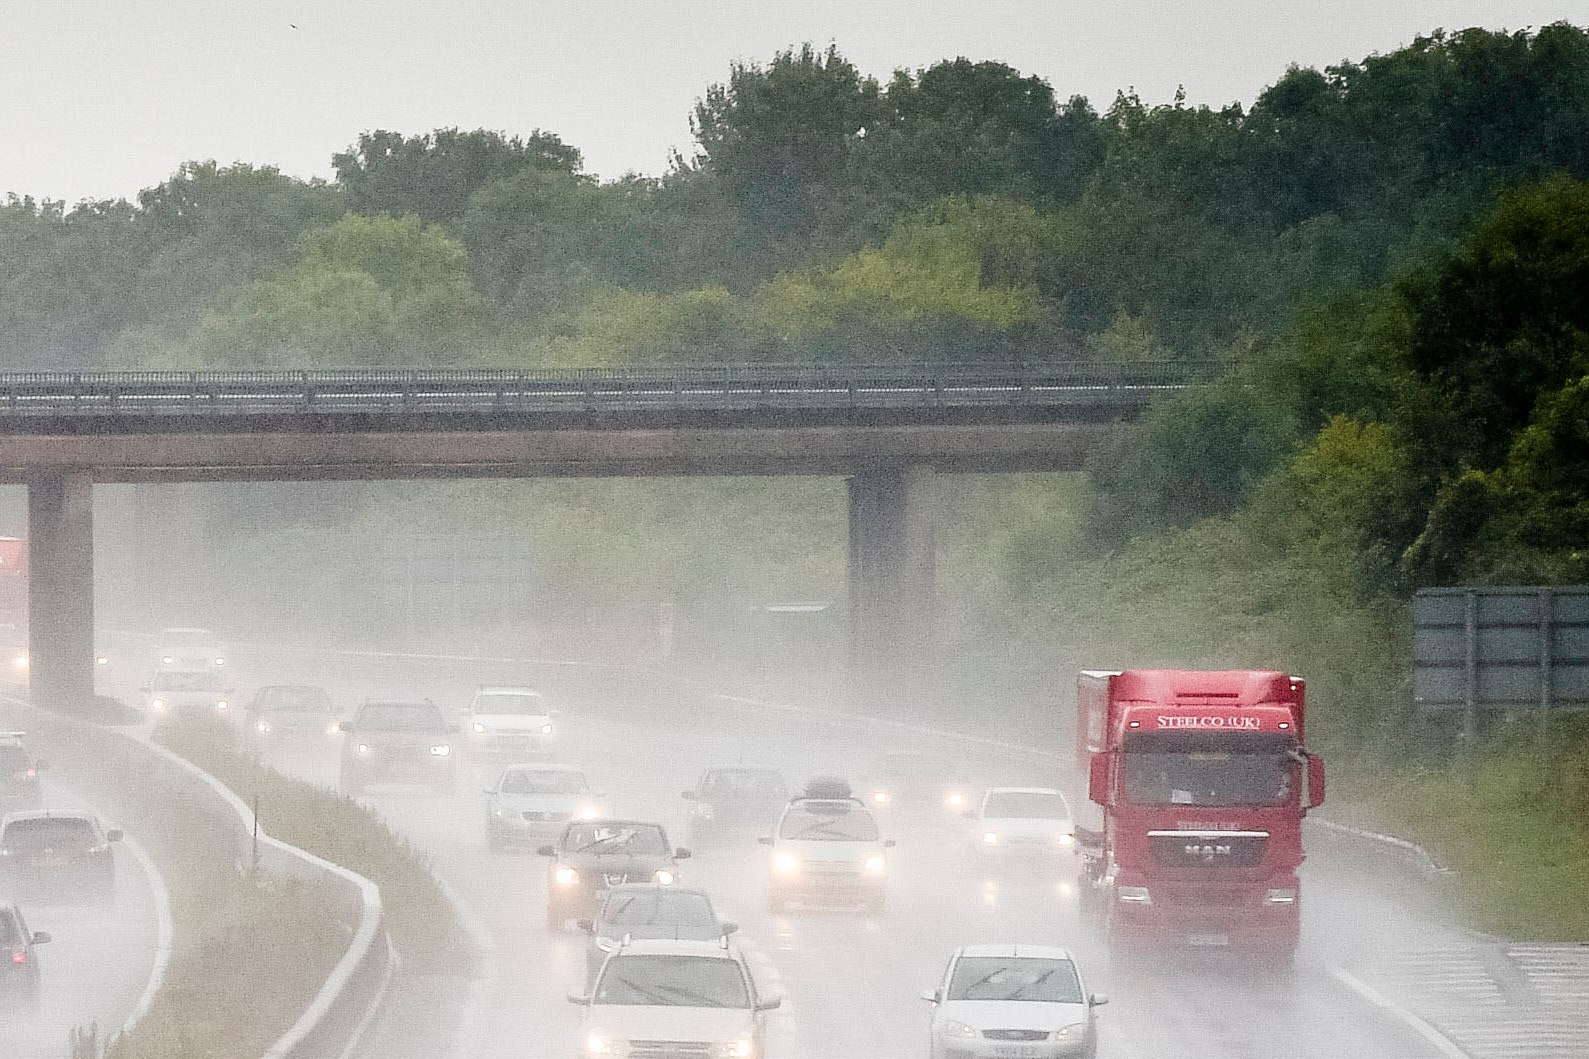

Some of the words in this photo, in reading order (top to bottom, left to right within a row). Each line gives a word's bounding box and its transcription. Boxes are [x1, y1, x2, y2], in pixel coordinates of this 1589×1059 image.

[1157, 715, 1223, 728] STEELCO
[1228, 716, 1261, 729] (UK)
[1185, 845, 1231, 855] MAN
